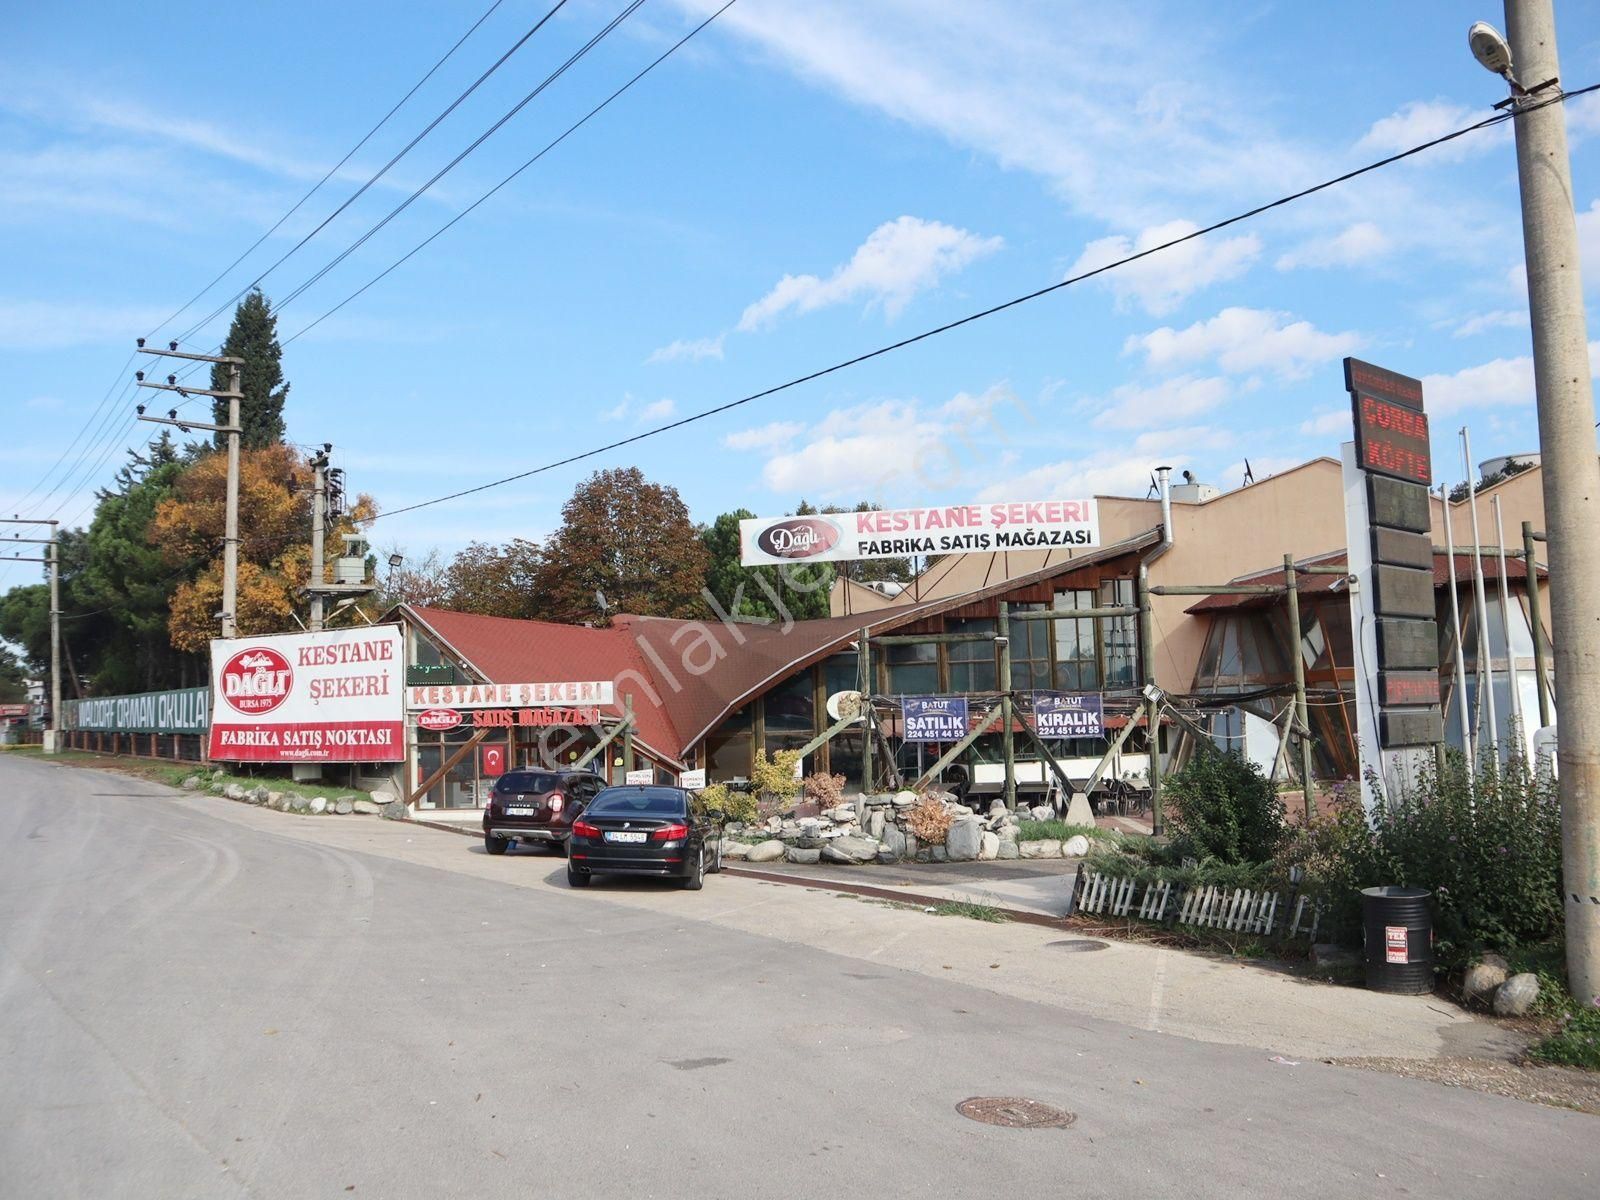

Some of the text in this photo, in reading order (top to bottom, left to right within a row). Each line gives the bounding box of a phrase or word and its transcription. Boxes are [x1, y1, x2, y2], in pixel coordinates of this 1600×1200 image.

[1368, 440, 1428, 479] KÖFTE
[857, 506, 983, 534] KESTANE
[940, 533, 991, 550] SATIŞ
[995, 528, 1092, 547] MAĞAZASI
[298, 640, 393, 667] KESTANE
[225, 666, 287, 697] DAĞLI
[309, 669, 390, 706] ŞEKERİ
[239, 698, 273, 709] BURSA 1975
[413, 684, 512, 705] KESTANE
[921, 701, 949, 710] BATUT
[1054, 697, 1083, 705] BATUT
[79, 699, 116, 728] WALDORF
[117, 696, 156, 729] ORMAN
[473, 706, 600, 729] SATIŞ MAĞAZASI
[906, 717, 964, 730] SATILIK
[220, 726, 392, 749] FABRİKA SATIŞ NOKTASI
[907, 730, 965, 739] 224 451 44 55
[1038, 726, 1100, 736] 224 451 44 55
[280, 748, 330, 757] www.dagli.com.tr
